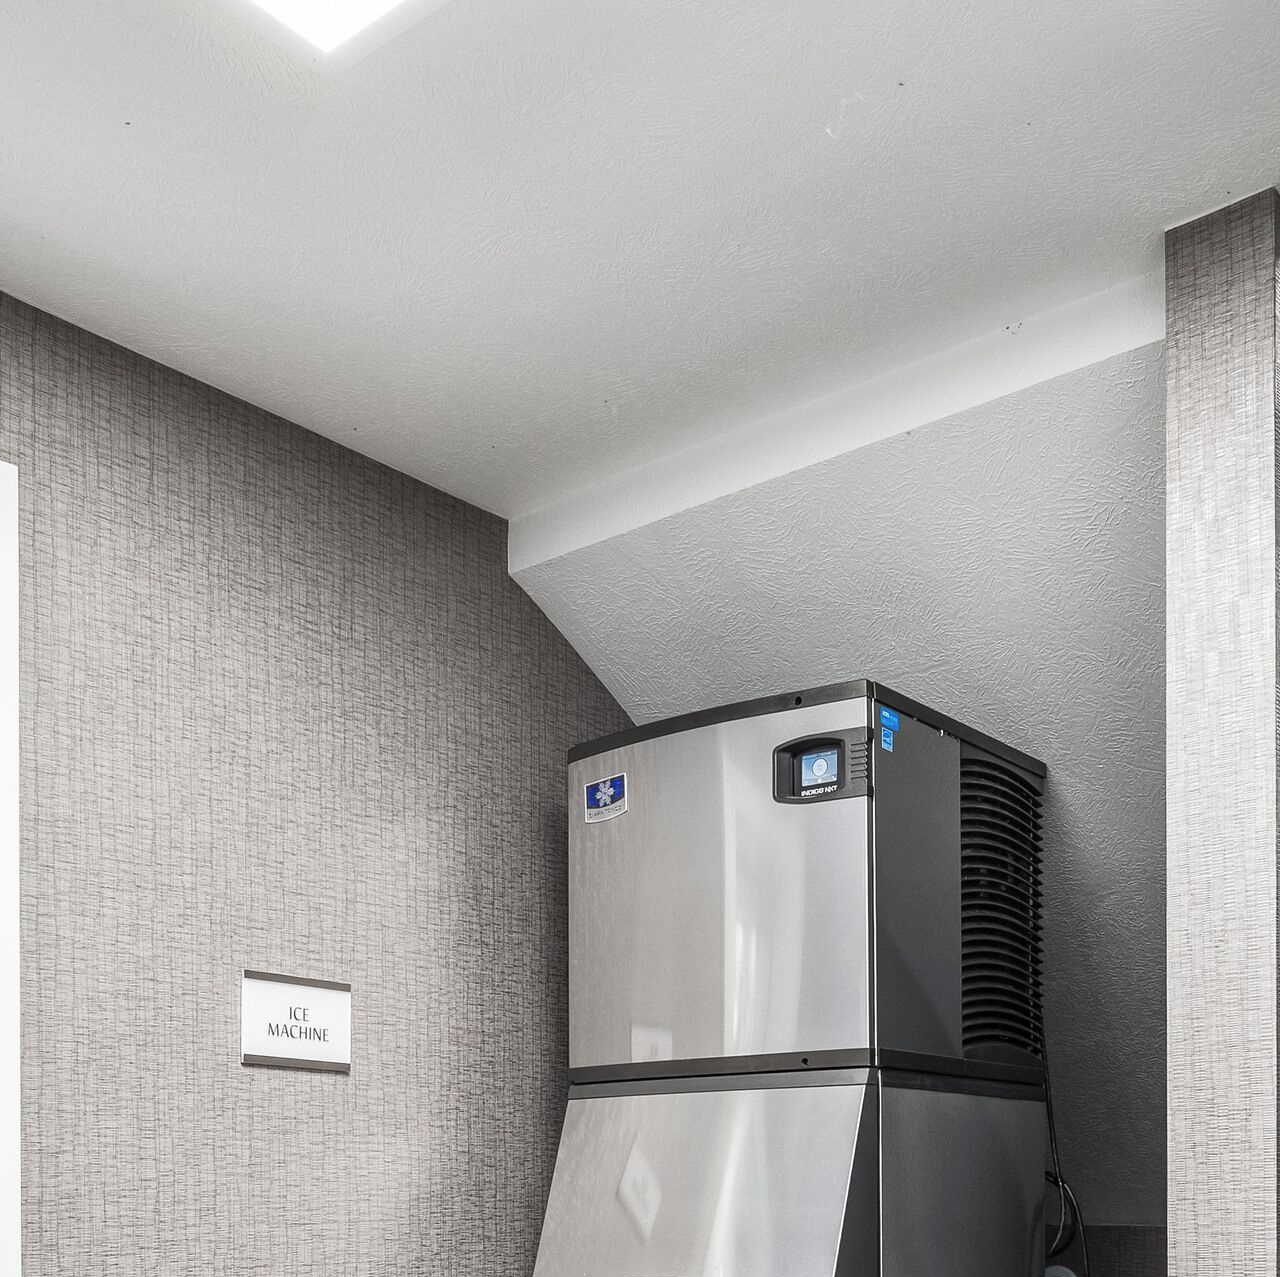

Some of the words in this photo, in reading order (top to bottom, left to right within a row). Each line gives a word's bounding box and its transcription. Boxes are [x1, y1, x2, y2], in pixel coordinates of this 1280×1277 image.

[801, 787, 825, 797] INDIGO
[824, 784, 838, 793] NXT
[289, 1006, 309, 1022] ICE
[268, 1022, 330, 1043] MACHINE
